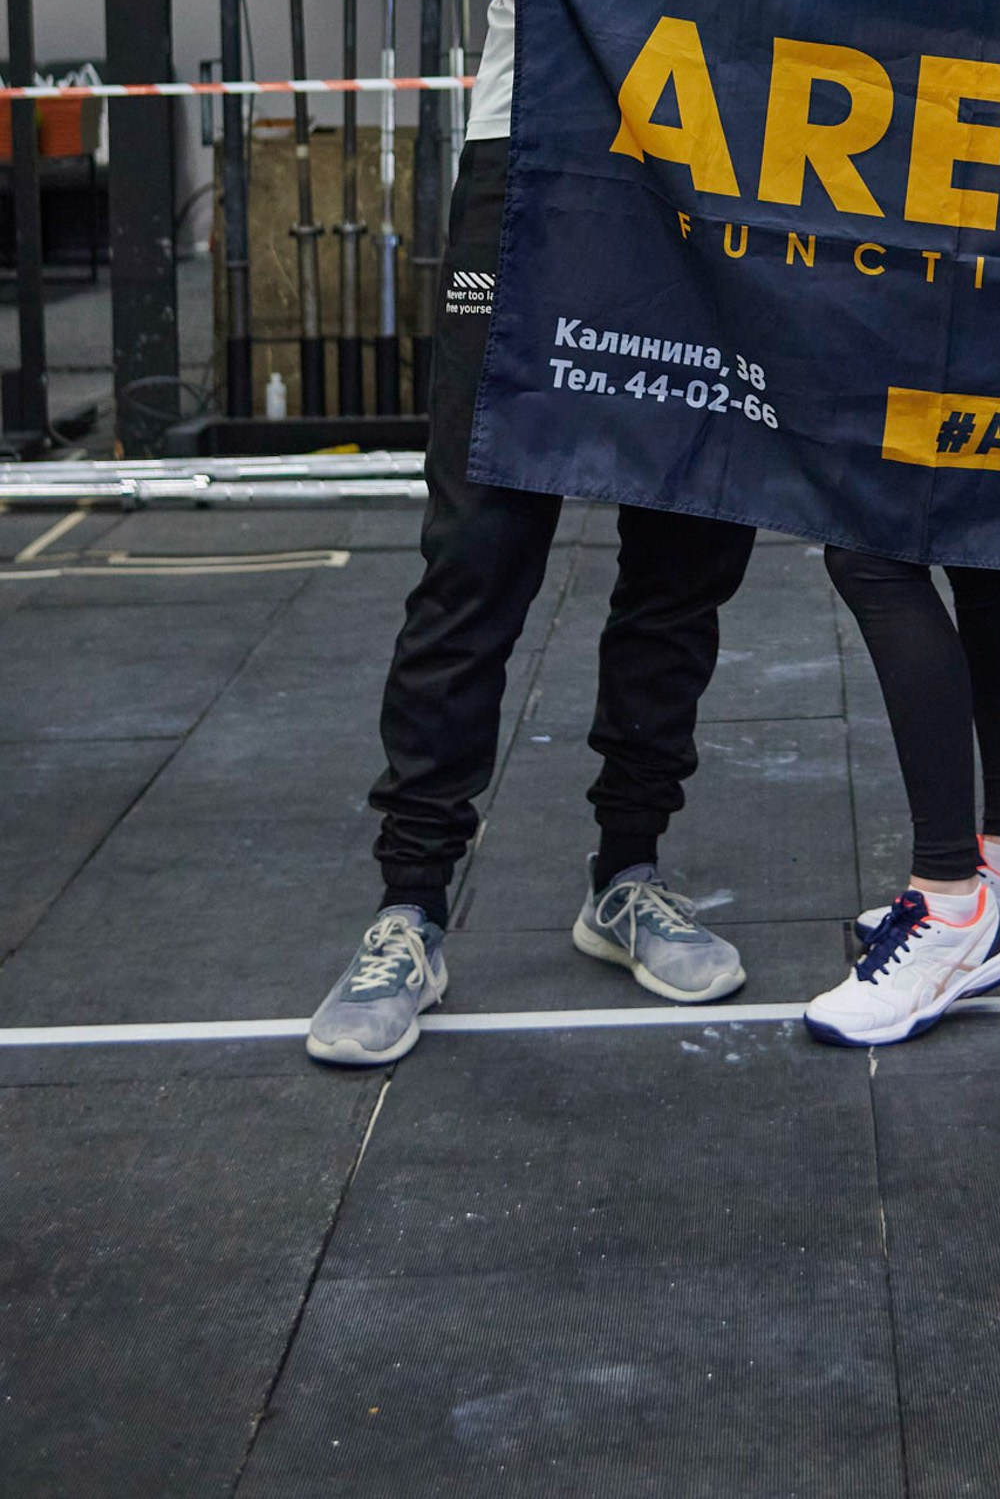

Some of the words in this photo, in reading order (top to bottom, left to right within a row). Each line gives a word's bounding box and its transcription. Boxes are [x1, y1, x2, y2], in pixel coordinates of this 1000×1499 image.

[459, 304, 493, 315] yourse
[468, 290, 485, 301] too
[554, 317, 730, 378] Калинина,
[735, 353, 767, 391] 38
[549, 358, 616, 395] Тел.
[624, 370, 779, 429] 44-02-66
